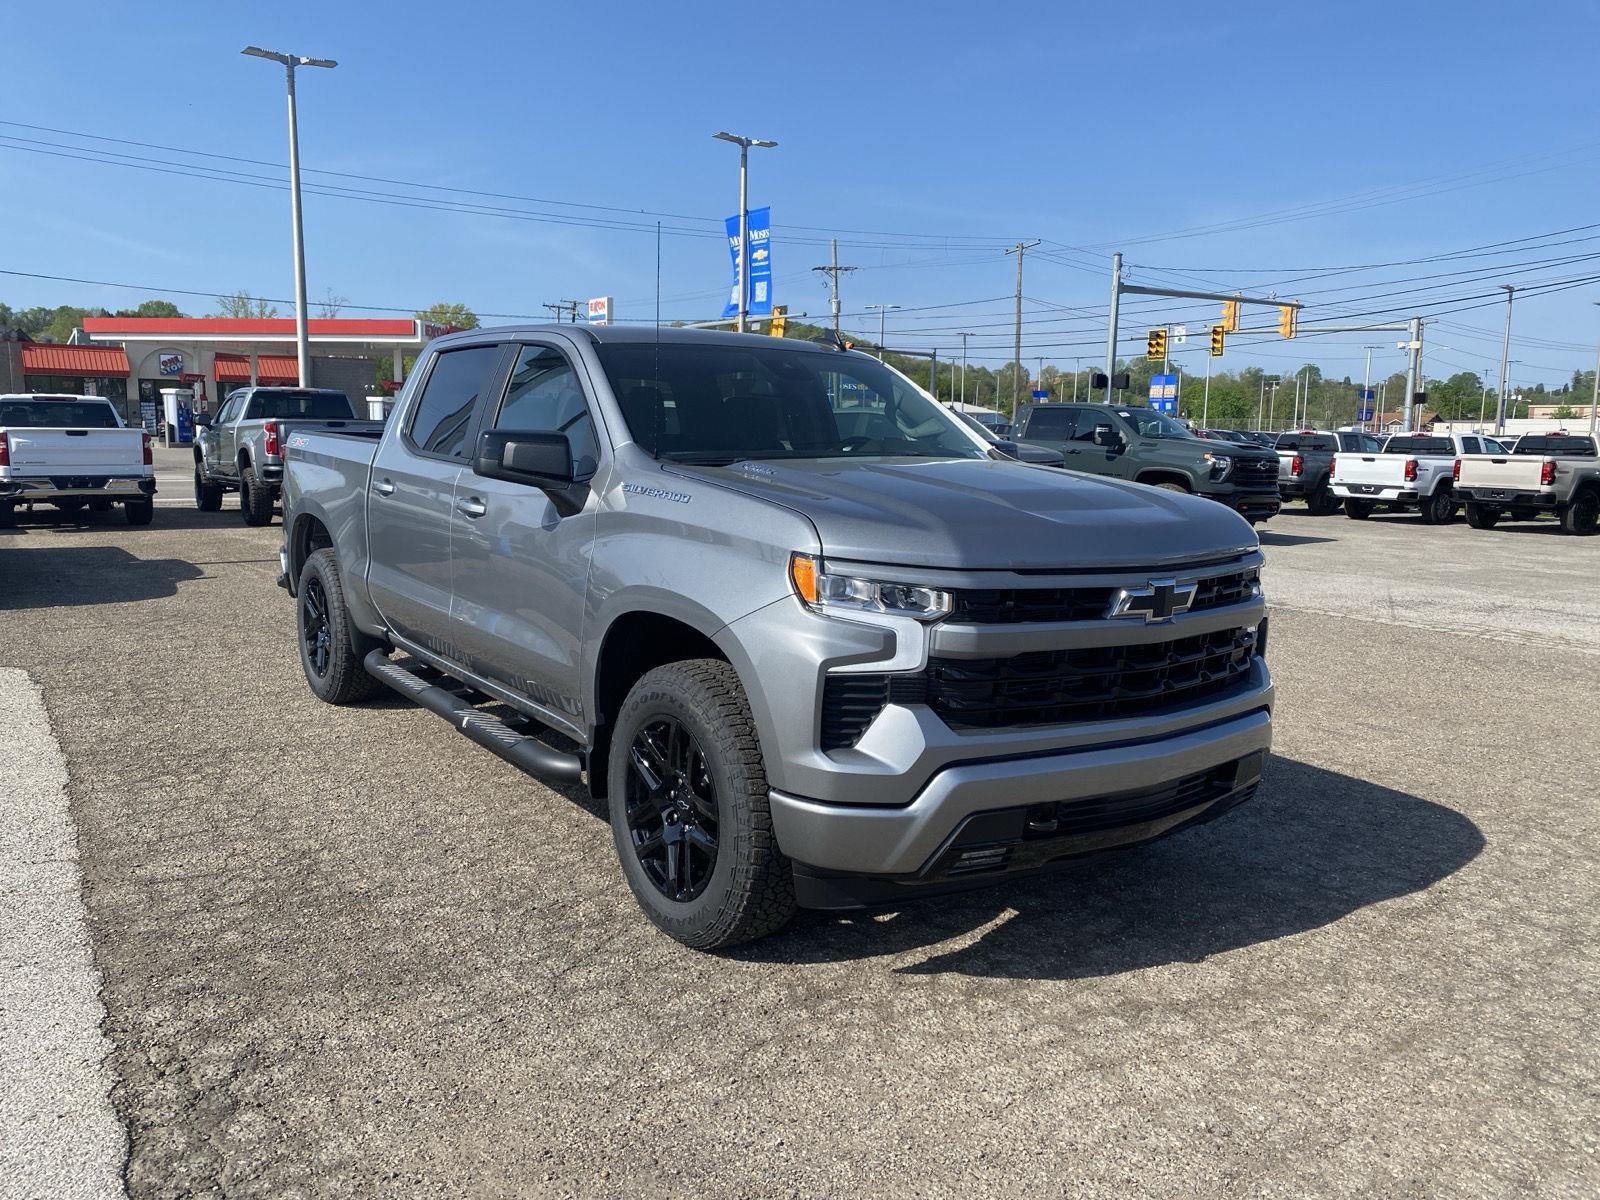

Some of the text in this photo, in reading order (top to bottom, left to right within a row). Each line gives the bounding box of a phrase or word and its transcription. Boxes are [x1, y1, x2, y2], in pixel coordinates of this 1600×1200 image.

[749, 228, 770, 241] MOSES
[590, 301, 606, 314] EXXON
[160, 362, 183, 374] STOP
[623, 483, 691, 504] SILVERADO
